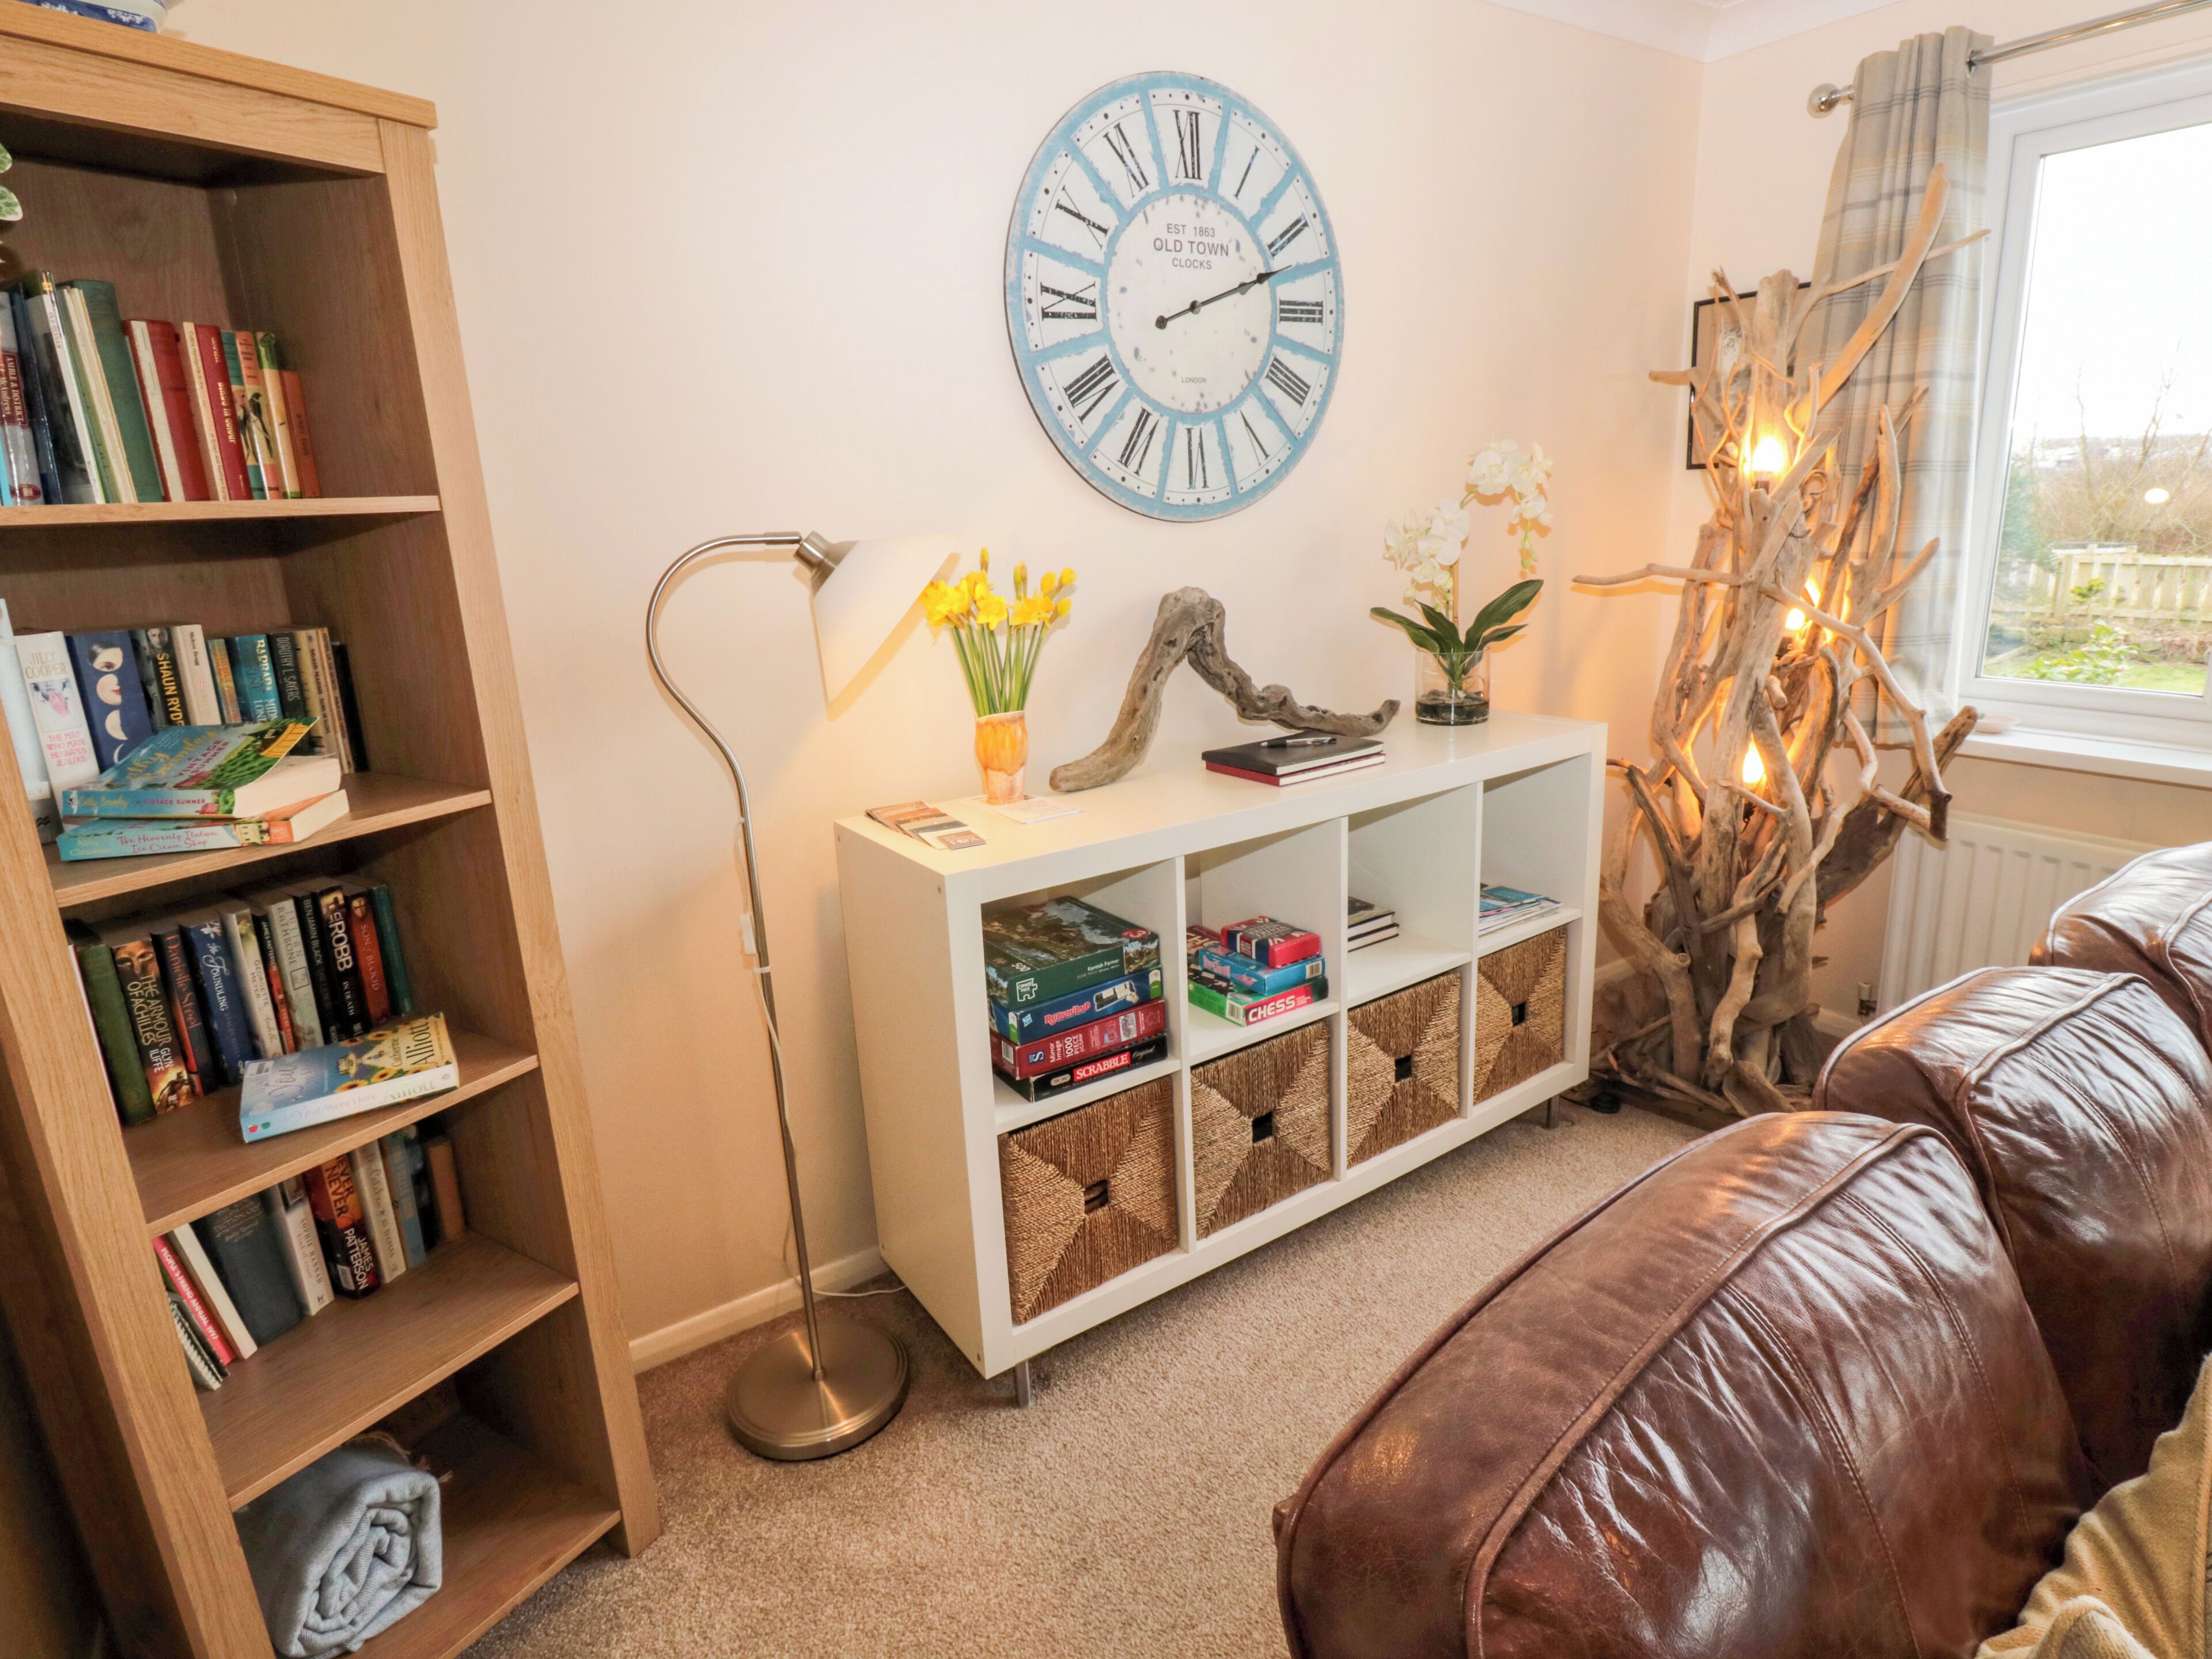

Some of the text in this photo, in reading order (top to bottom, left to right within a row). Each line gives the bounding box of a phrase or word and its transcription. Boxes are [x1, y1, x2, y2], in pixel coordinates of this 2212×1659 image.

[1172, 110, 1202, 180] XII
[1153, 237, 1229, 257] OLD TOWN
[1166, 223, 1215, 238] EST 1863
[1172, 257, 1212, 270] CLOCKS
[5, 355, 17, 381] AMBLE
[11, 388, 24, 422] DISTRICT
[29, 651, 55, 665] JILLY
[276, 636, 293, 668] DOROTHY
[24, 662, 67, 679] COOPER
[156, 651, 177, 696] SHAUN
[283, 675, 300, 701] SAYERS
[46, 738, 86, 750] WHO MADE
[48, 733, 62, 741] THE
[117, 828, 218, 845] The Heavenly Italian
[130, 836, 208, 853] Ice Cream Shop
[262, 921, 277, 971] JAMES PATTERSON
[277, 906, 296, 966] RATHBONE
[302, 899, 318, 939] BENJAMIN
[310, 939, 323, 965] BLACK
[328, 919, 354, 972] ROBB
[359, 923, 372, 945] SON
[366, 954, 380, 991] BLOOD
[1011, 963, 1031, 972] 500
[1087, 963, 1104, 972] Kentish
[1104, 958, 1120, 967] Farmer
[165, 934, 202, 1029] Danielle Steel
[249, 971, 260, 999] HEYER
[253, 959, 269, 1007] GEORGETTE
[342, 981, 355, 1016] IN DEATH
[141, 973, 175, 1068] THE ARMOUR GLYN
[1044, 1001, 1092, 1026] Rummikub
[1248, 995, 1296, 1022] CHESS
[127, 980, 164, 1073] OF ACHILLES ILIFFE
[389, 1036, 403, 1067] Catherine
[405, 1020, 438, 1071] Alliott
[1065, 1036, 1074, 1058] 1000
[1075, 1054, 1128, 1080] SCRABBLE
[1132, 1044, 1156, 1060] Original
[321, 1164, 352, 1218] NEVER
[300, 1218, 323, 1283] SOPHIE HANNAH
[340, 1227, 373, 1290] PATTERSON
[355, 1236, 376, 1272] JAMES
[160, 1247, 219, 1340] PEOPLE'S FRIEND ANNUAL 1997
